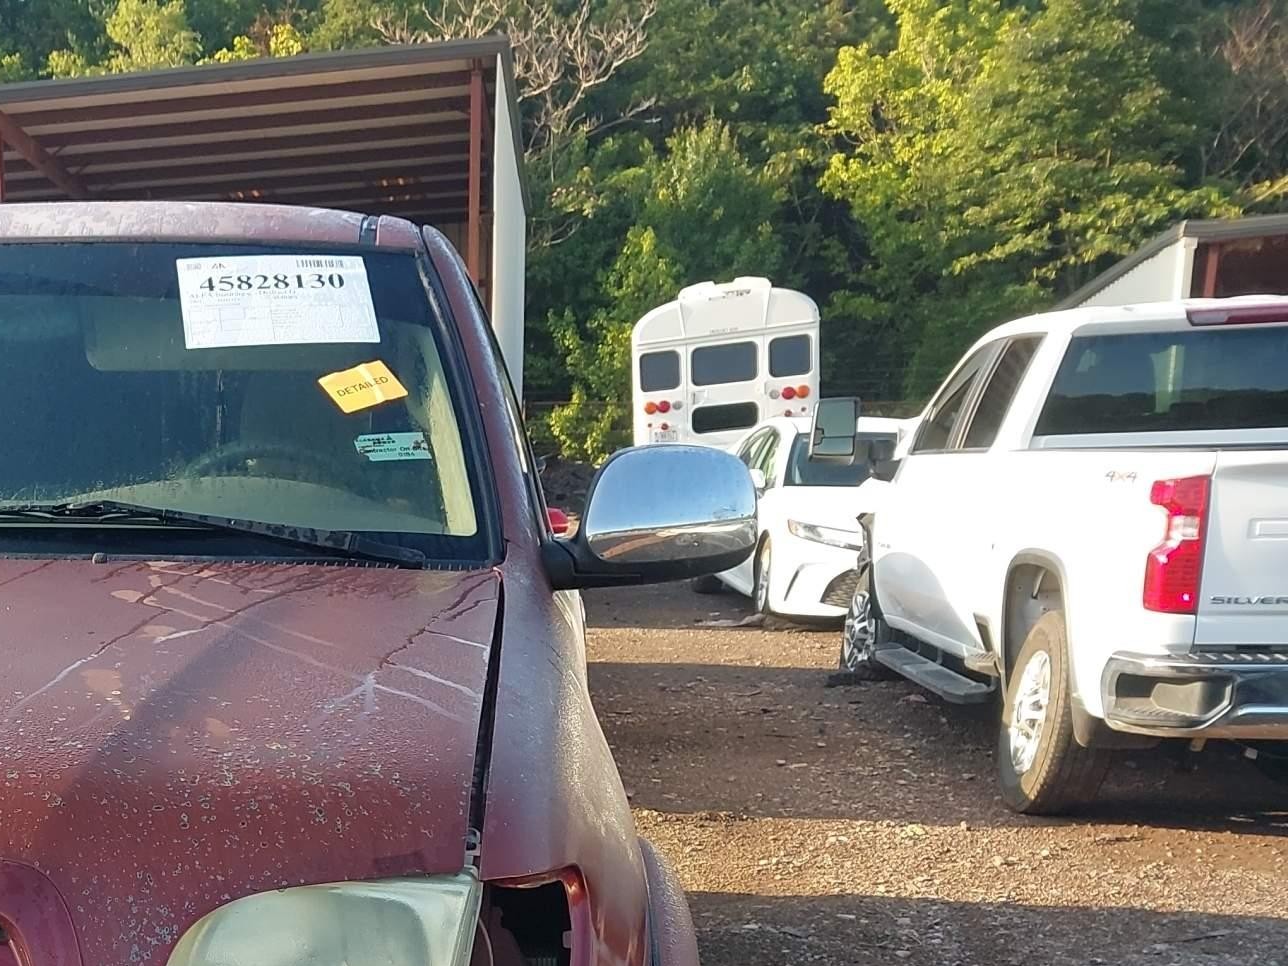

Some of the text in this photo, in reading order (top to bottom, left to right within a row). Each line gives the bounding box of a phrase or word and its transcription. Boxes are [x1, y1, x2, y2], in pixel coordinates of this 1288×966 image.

[199, 272, 345, 292] 45828130
[335, 375, 390, 397] DETAILED
[1104, 469, 1138, 484] 4x4
